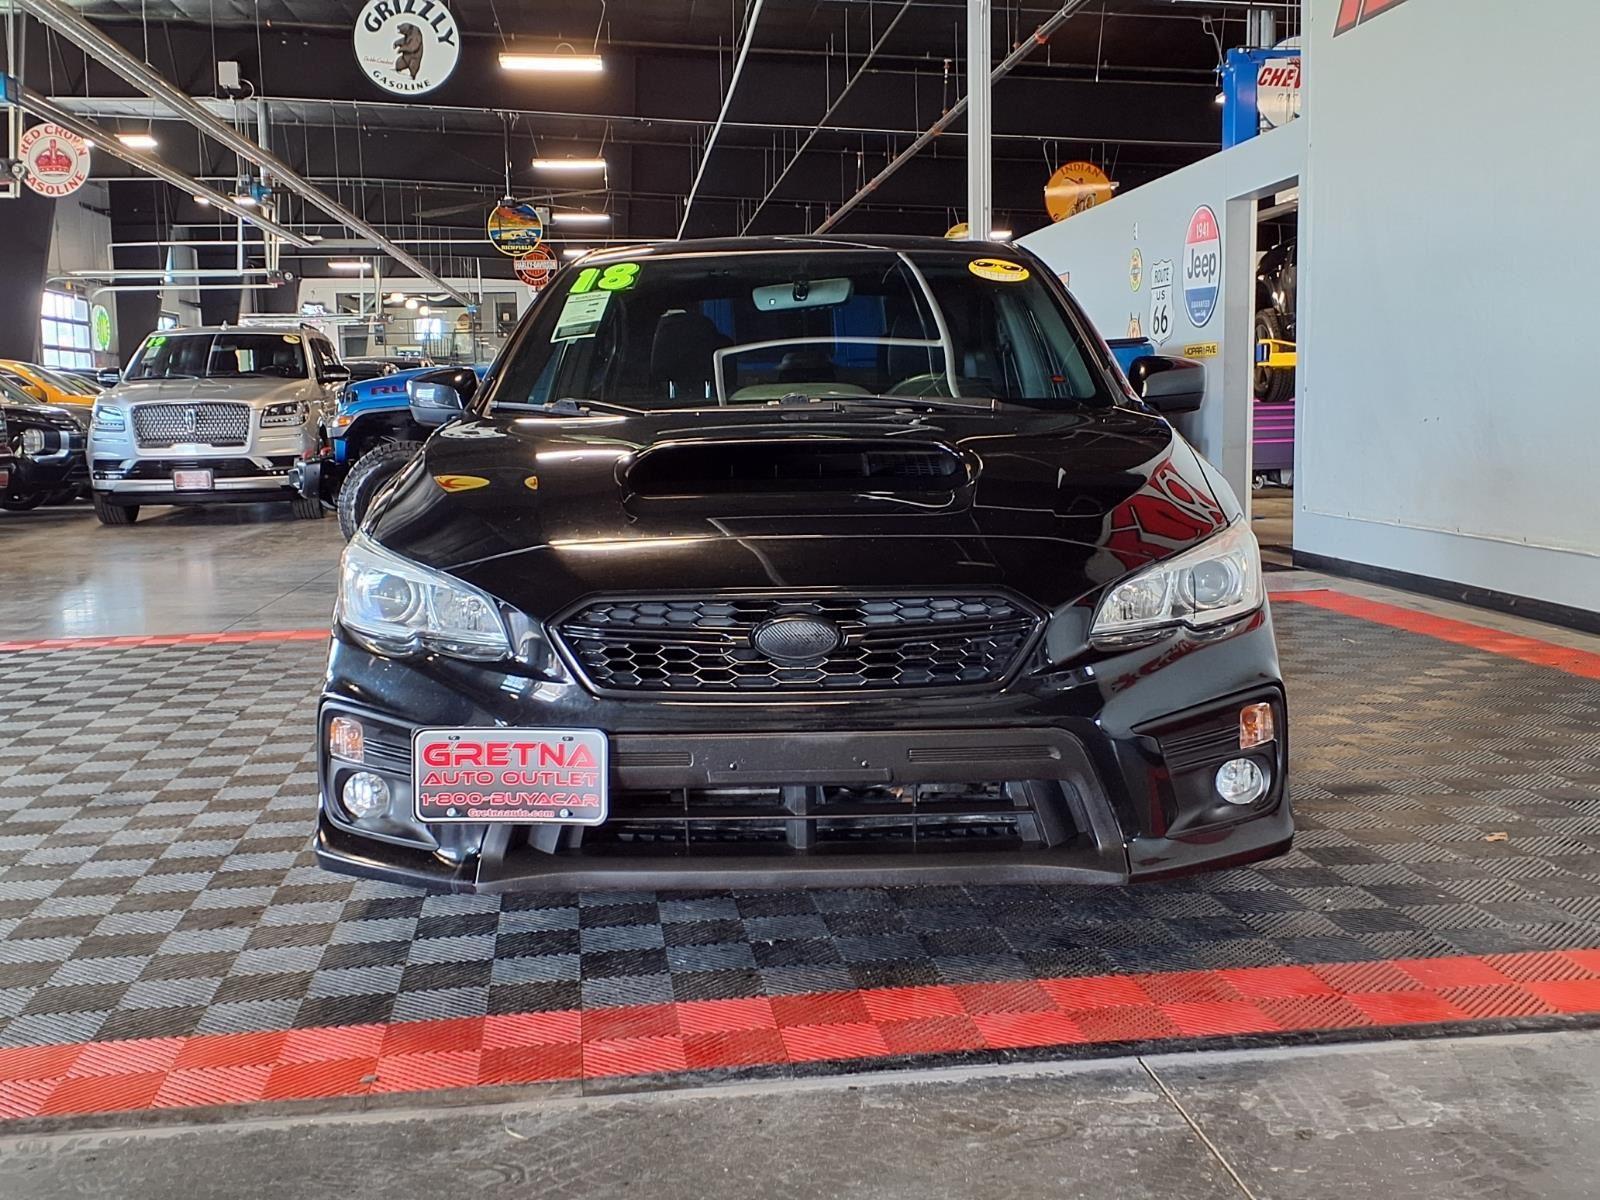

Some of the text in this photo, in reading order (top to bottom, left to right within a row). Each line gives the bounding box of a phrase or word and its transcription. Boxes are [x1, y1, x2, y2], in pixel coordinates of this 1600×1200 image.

[364, 0, 455, 46] GRIZZLY
[373, 70, 431, 91] GASOLINE
[20, 129, 41, 154] RED
[1060, 163, 1102, 178] INDIAN
[1196, 222, 1209, 239] 1941
[1154, 267, 1169, 284] ROUTE
[1187, 248, 1217, 284] Jeep
[569, 262, 640, 294] 18
[1156, 290, 1166, 301] US
[1152, 305, 1168, 334] 66
[422, 741, 598, 768] GRETNA
[421, 771, 598, 787] AUTO OUTLET
[421, 792, 599, 807] 1-800-BUYACAR
[468, 808, 555, 818] Gretnaauto.com
